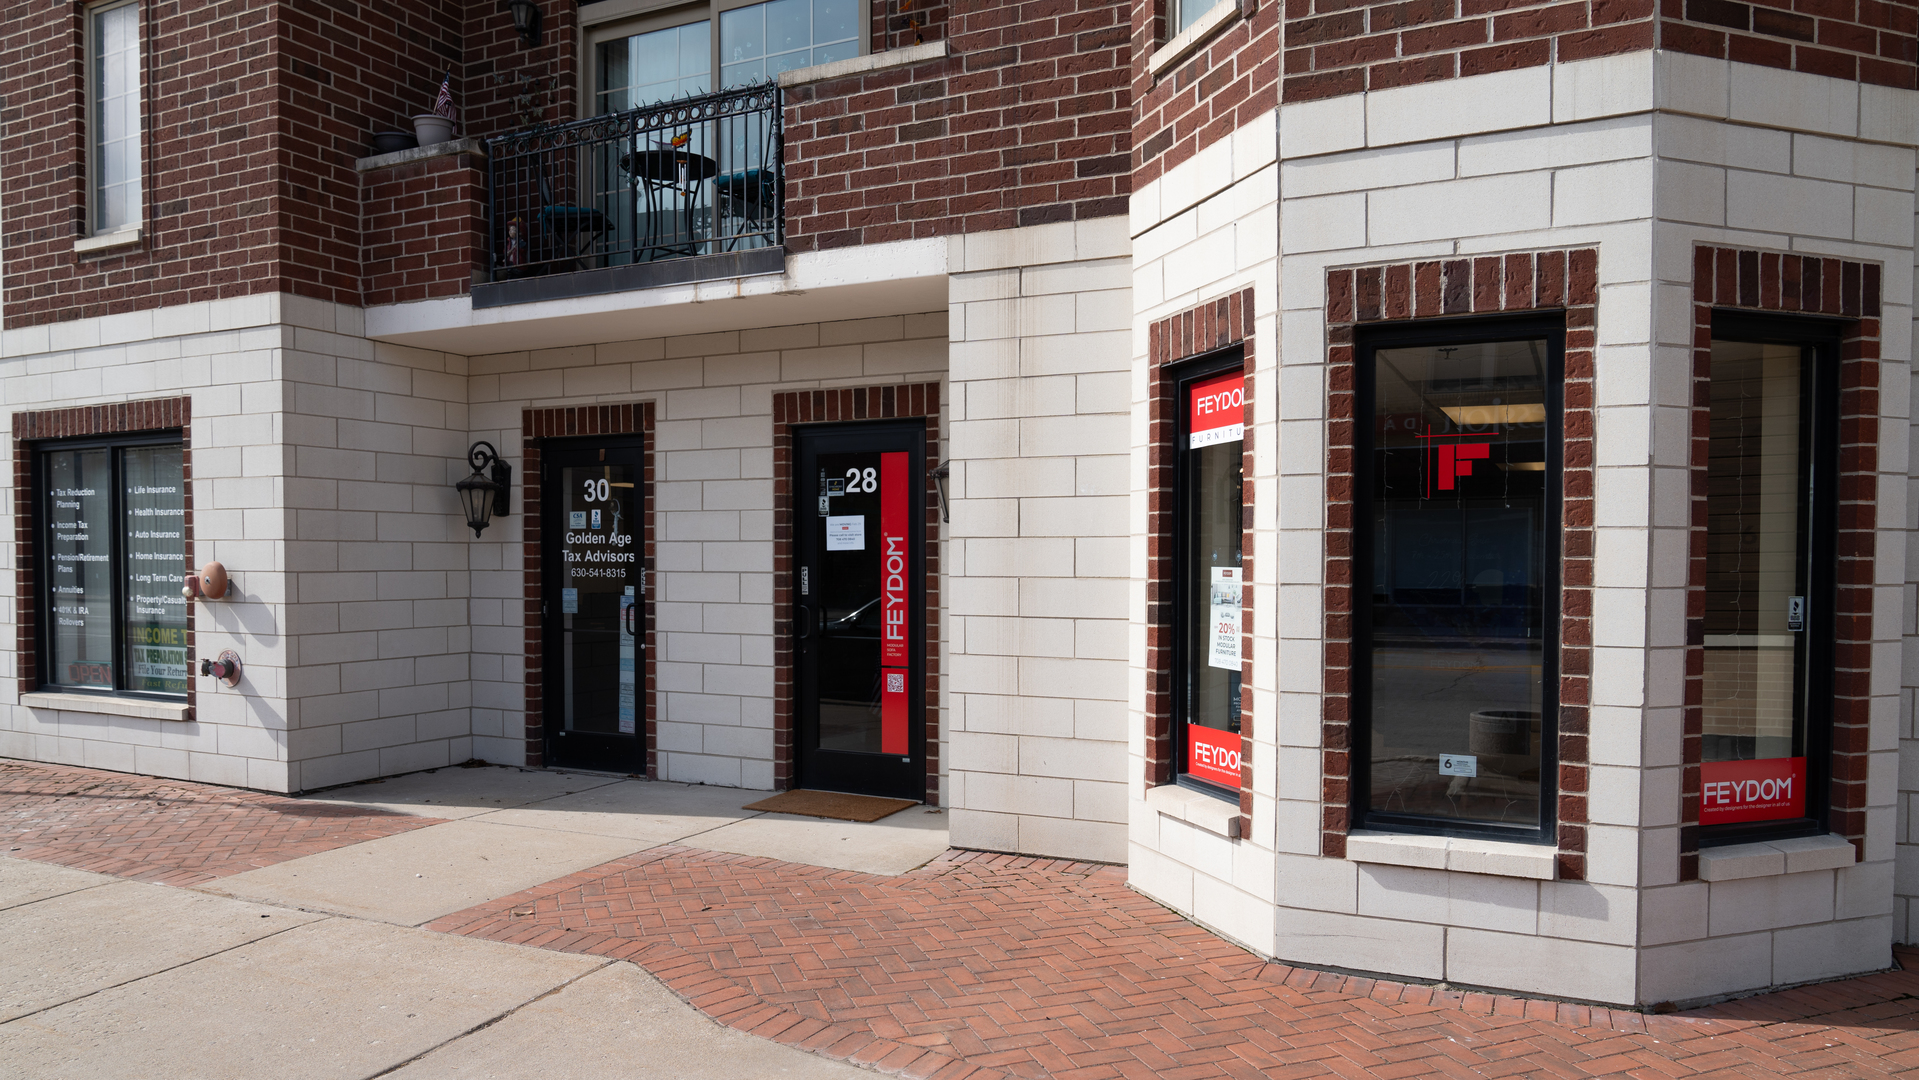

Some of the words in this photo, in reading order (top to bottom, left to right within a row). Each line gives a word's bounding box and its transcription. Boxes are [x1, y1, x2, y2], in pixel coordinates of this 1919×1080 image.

[845, 467, 878, 494] 28
[56, 488, 66, 496] Tax
[67, 488, 95, 496] Reduction
[134, 486, 145, 494] Life
[146, 485, 176, 494] Insurance
[583, 478, 610, 503] 30
[56, 501, 80, 510] Planning
[134, 508, 154, 516] Health
[155, 508, 184, 516] Insurance
[56, 521, 77, 529] Income
[78, 521, 88, 529] Tax
[57, 533, 89, 542] Preparation
[135, 530, 149, 538] Auto
[150, 530, 180, 539] Insurance
[566, 532, 606, 545] Golden
[608, 532, 632, 547] Age
[57, 553, 109, 562] Pension/Retirement
[135, 552, 153, 560] Home
[154, 552, 183, 560] Insurance
[562, 549, 581, 563] Tax
[584, 549, 635, 563] Advisors
[58, 565, 73, 573] Plans
[571, 568, 626, 578] 630-541-8315
[136, 573, 151, 583] Long
[152, 573, 168, 582] Term
[168, 574, 183, 583] Care
[58, 585, 84, 594] Annuities
[886, 536, 904, 641] FEYDOM
[58, 606, 72, 614] 401K
[73, 606, 77, 614] &
[78, 606, 89, 615] IRA
[136, 606, 165, 615] Insurance
[59, 617, 84, 627] Rollovers
[133, 627, 178, 645] INCOME
[181, 629, 187, 645] T
[134, 648, 145, 663] TAX
[146, 649, 183, 666] PREPARATION
[68, 664, 112, 684] OPEN
[138, 664, 150, 675] File
[150, 665, 166, 676] Your
[142, 679, 161, 688] Fast
[165, 680, 187, 690] Refu
[1444, 758, 1452, 769] 6
[1703, 777, 1792, 806] FEYDOM
